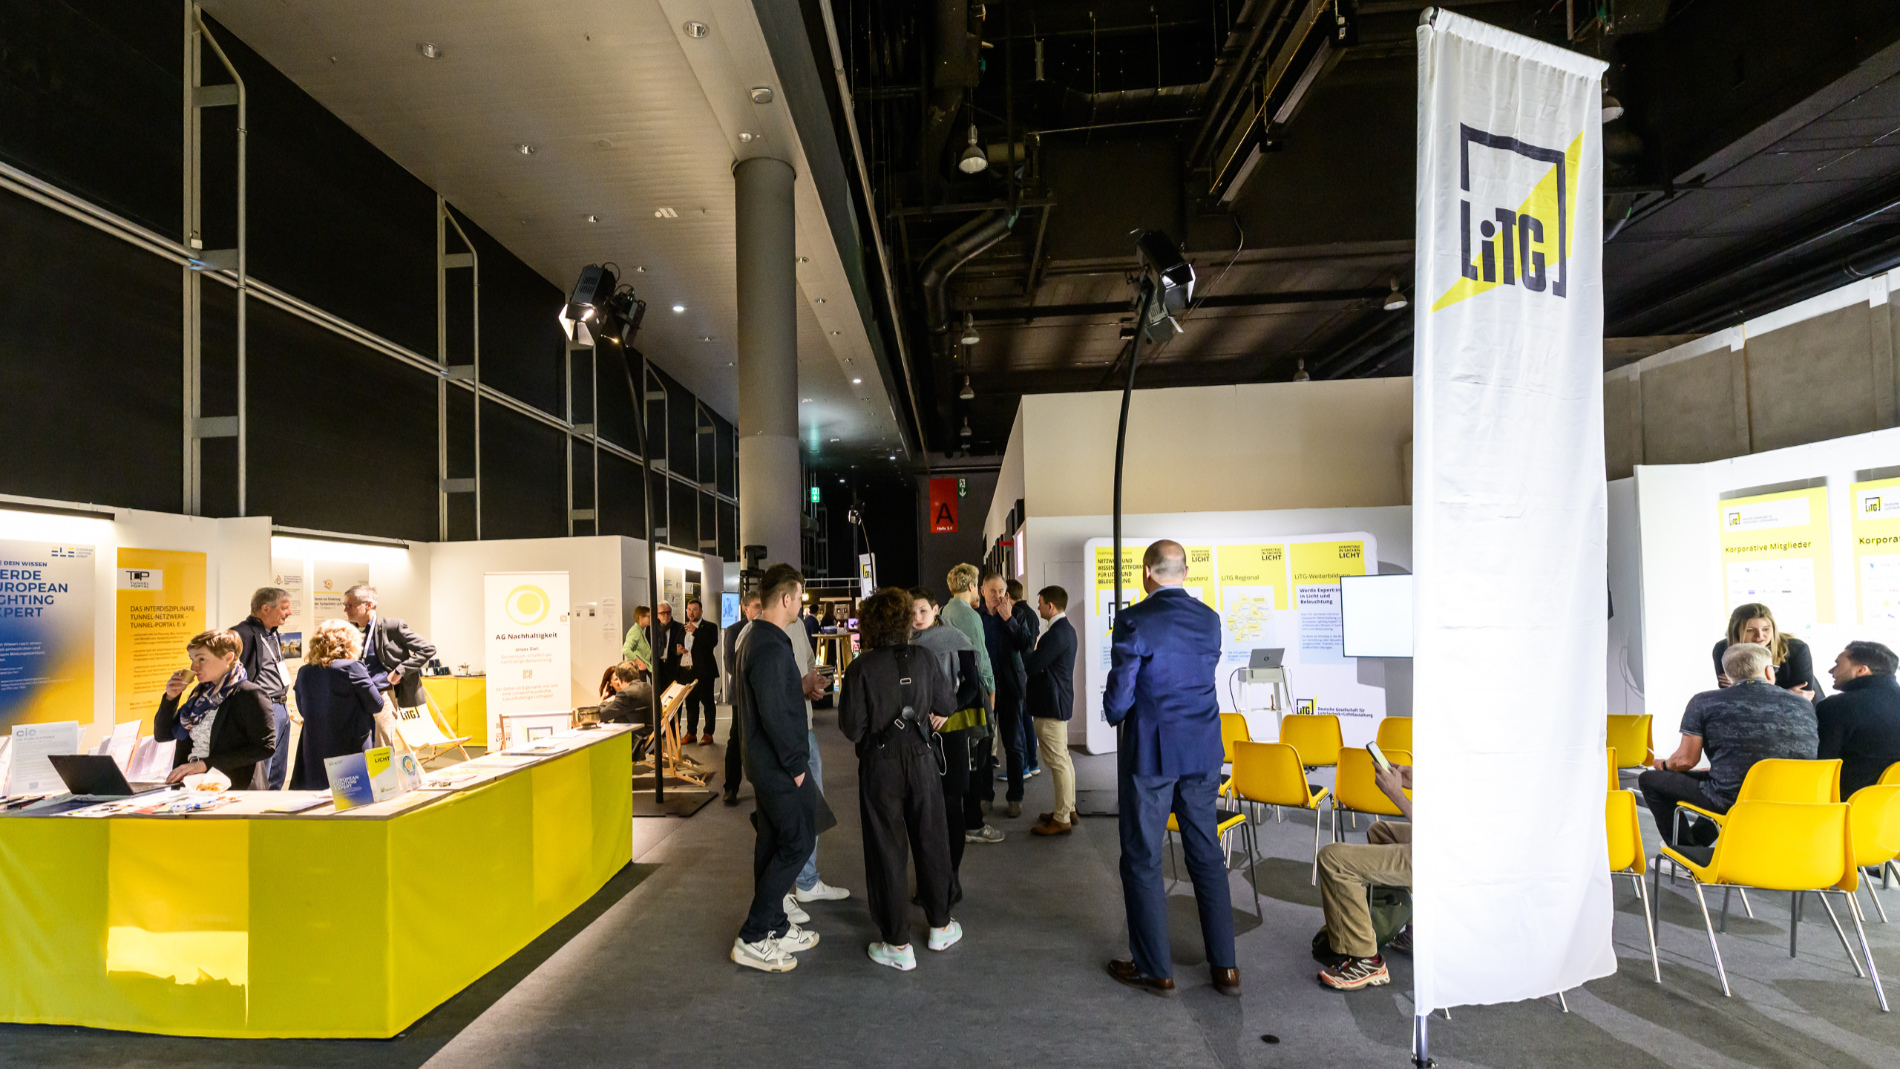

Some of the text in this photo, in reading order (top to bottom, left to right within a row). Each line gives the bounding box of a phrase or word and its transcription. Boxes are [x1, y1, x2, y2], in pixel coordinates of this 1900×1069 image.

[1461, 199, 1546, 292] LiTG
[936, 503, 954, 524] A
[1726, 541, 1812, 554] Korporative Mitglieder
[0, 607, 43, 618] PERT
[508, 632, 558, 640] Nachhaltigkeit
